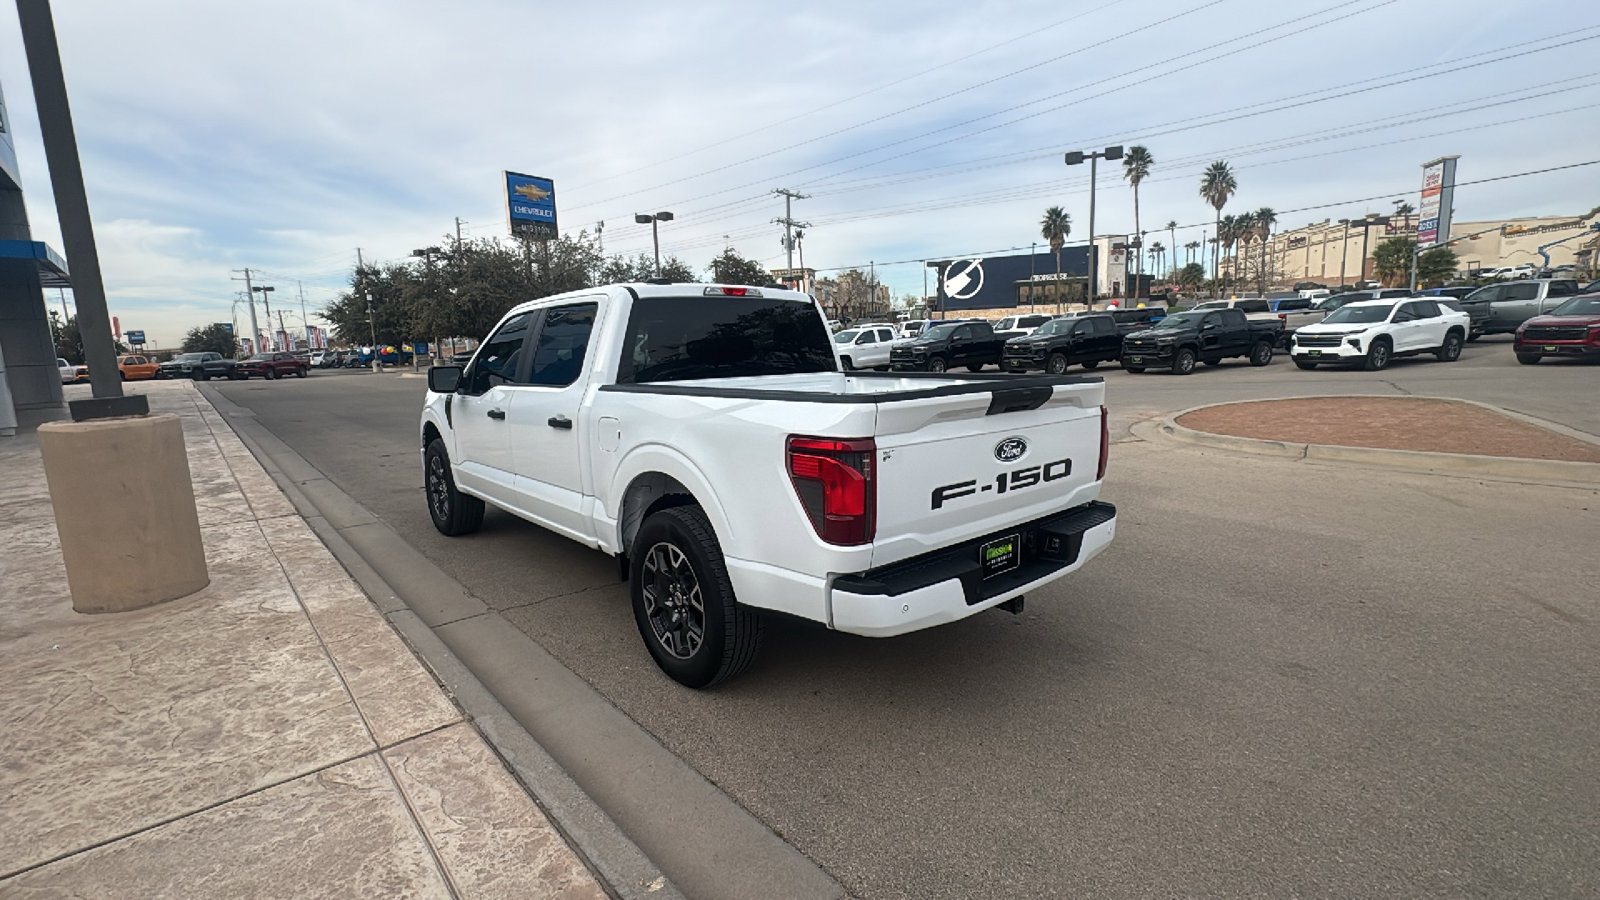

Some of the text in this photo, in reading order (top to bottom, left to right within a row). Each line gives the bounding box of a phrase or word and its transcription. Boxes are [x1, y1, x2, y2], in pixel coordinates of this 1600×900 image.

[514, 205, 552, 217] CHEVROLET
[1001, 441, 1023, 458] Ford
[931, 458, 1072, 511] F-150
